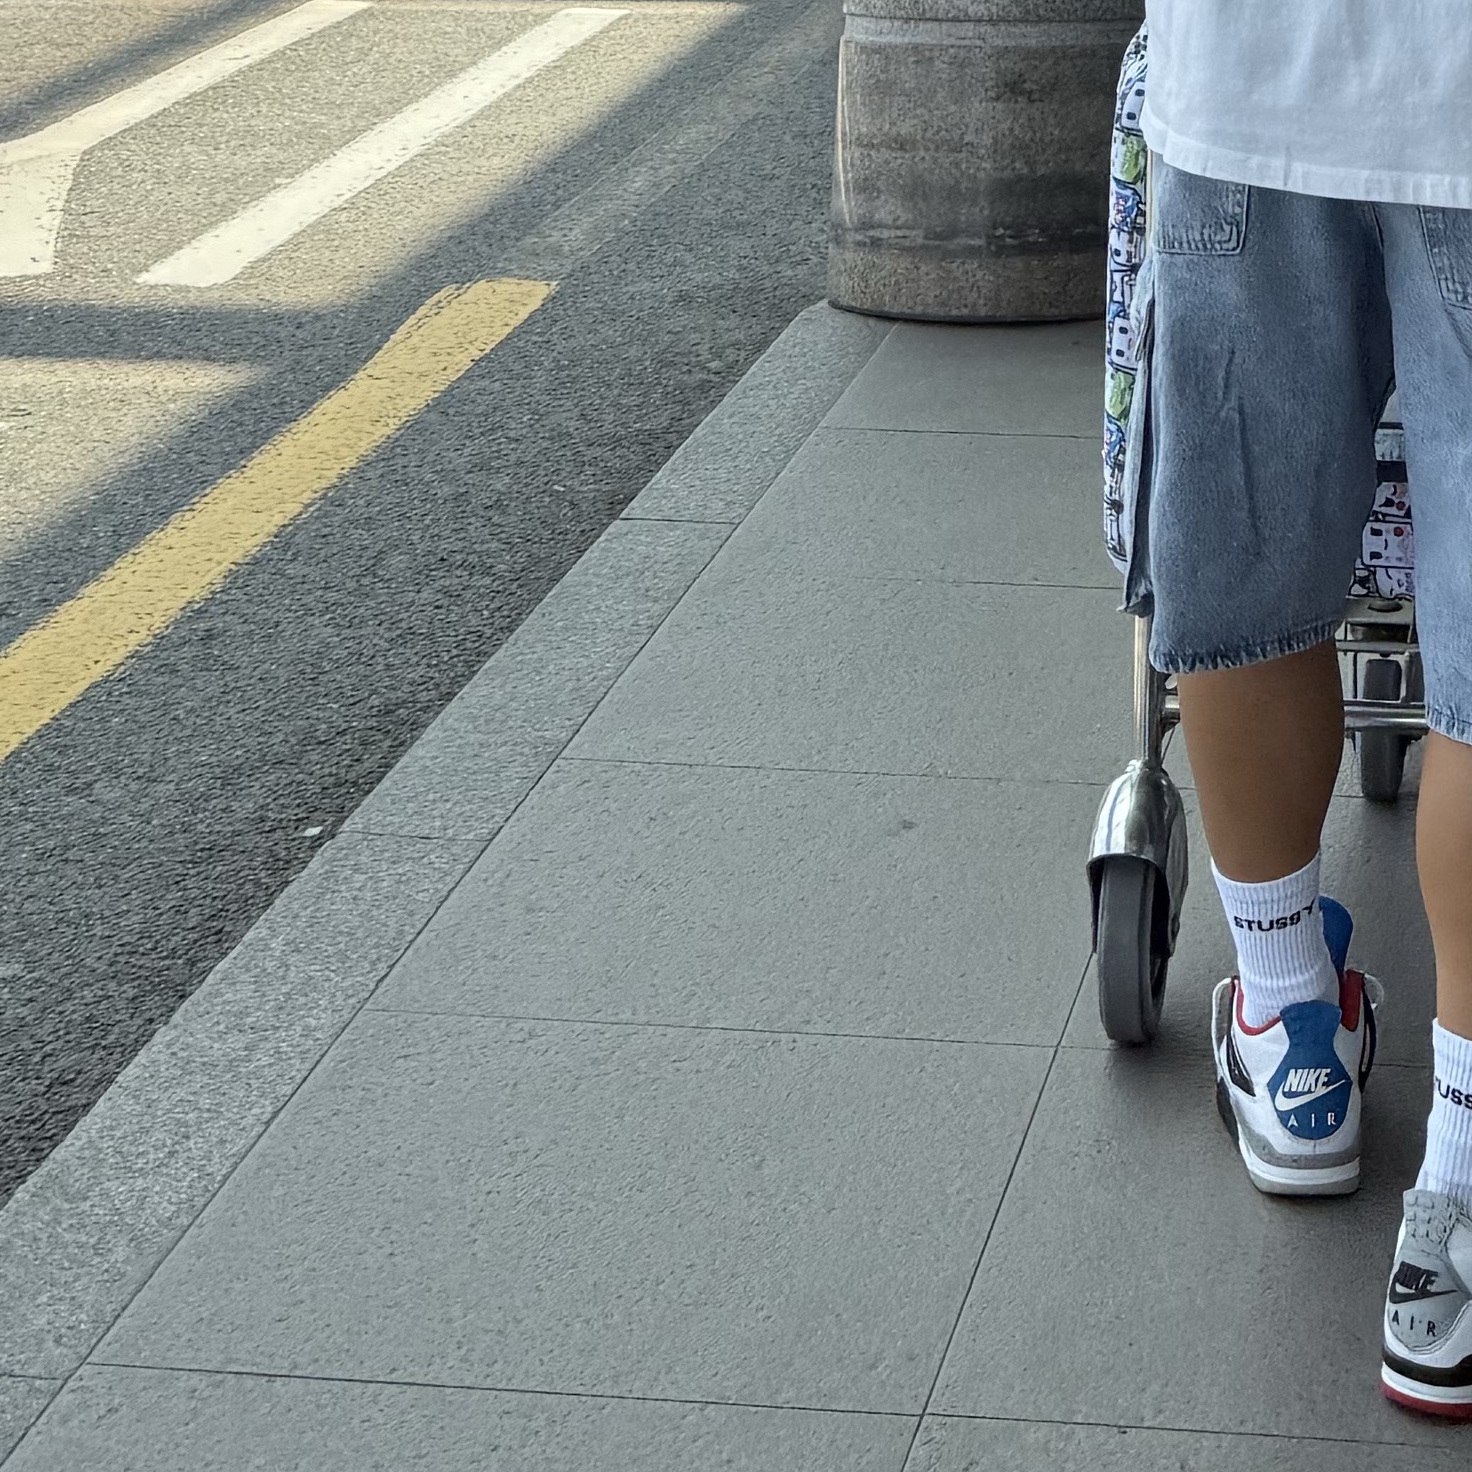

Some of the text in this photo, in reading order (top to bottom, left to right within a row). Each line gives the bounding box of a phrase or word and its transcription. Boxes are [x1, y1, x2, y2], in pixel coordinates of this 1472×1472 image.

[1233, 896, 1316, 932] STUSSY
[1283, 1066, 1333, 1093] NIKE
[1286, 1111, 1337, 1128] AIR
[1391, 1309, 1437, 1337] AIR
